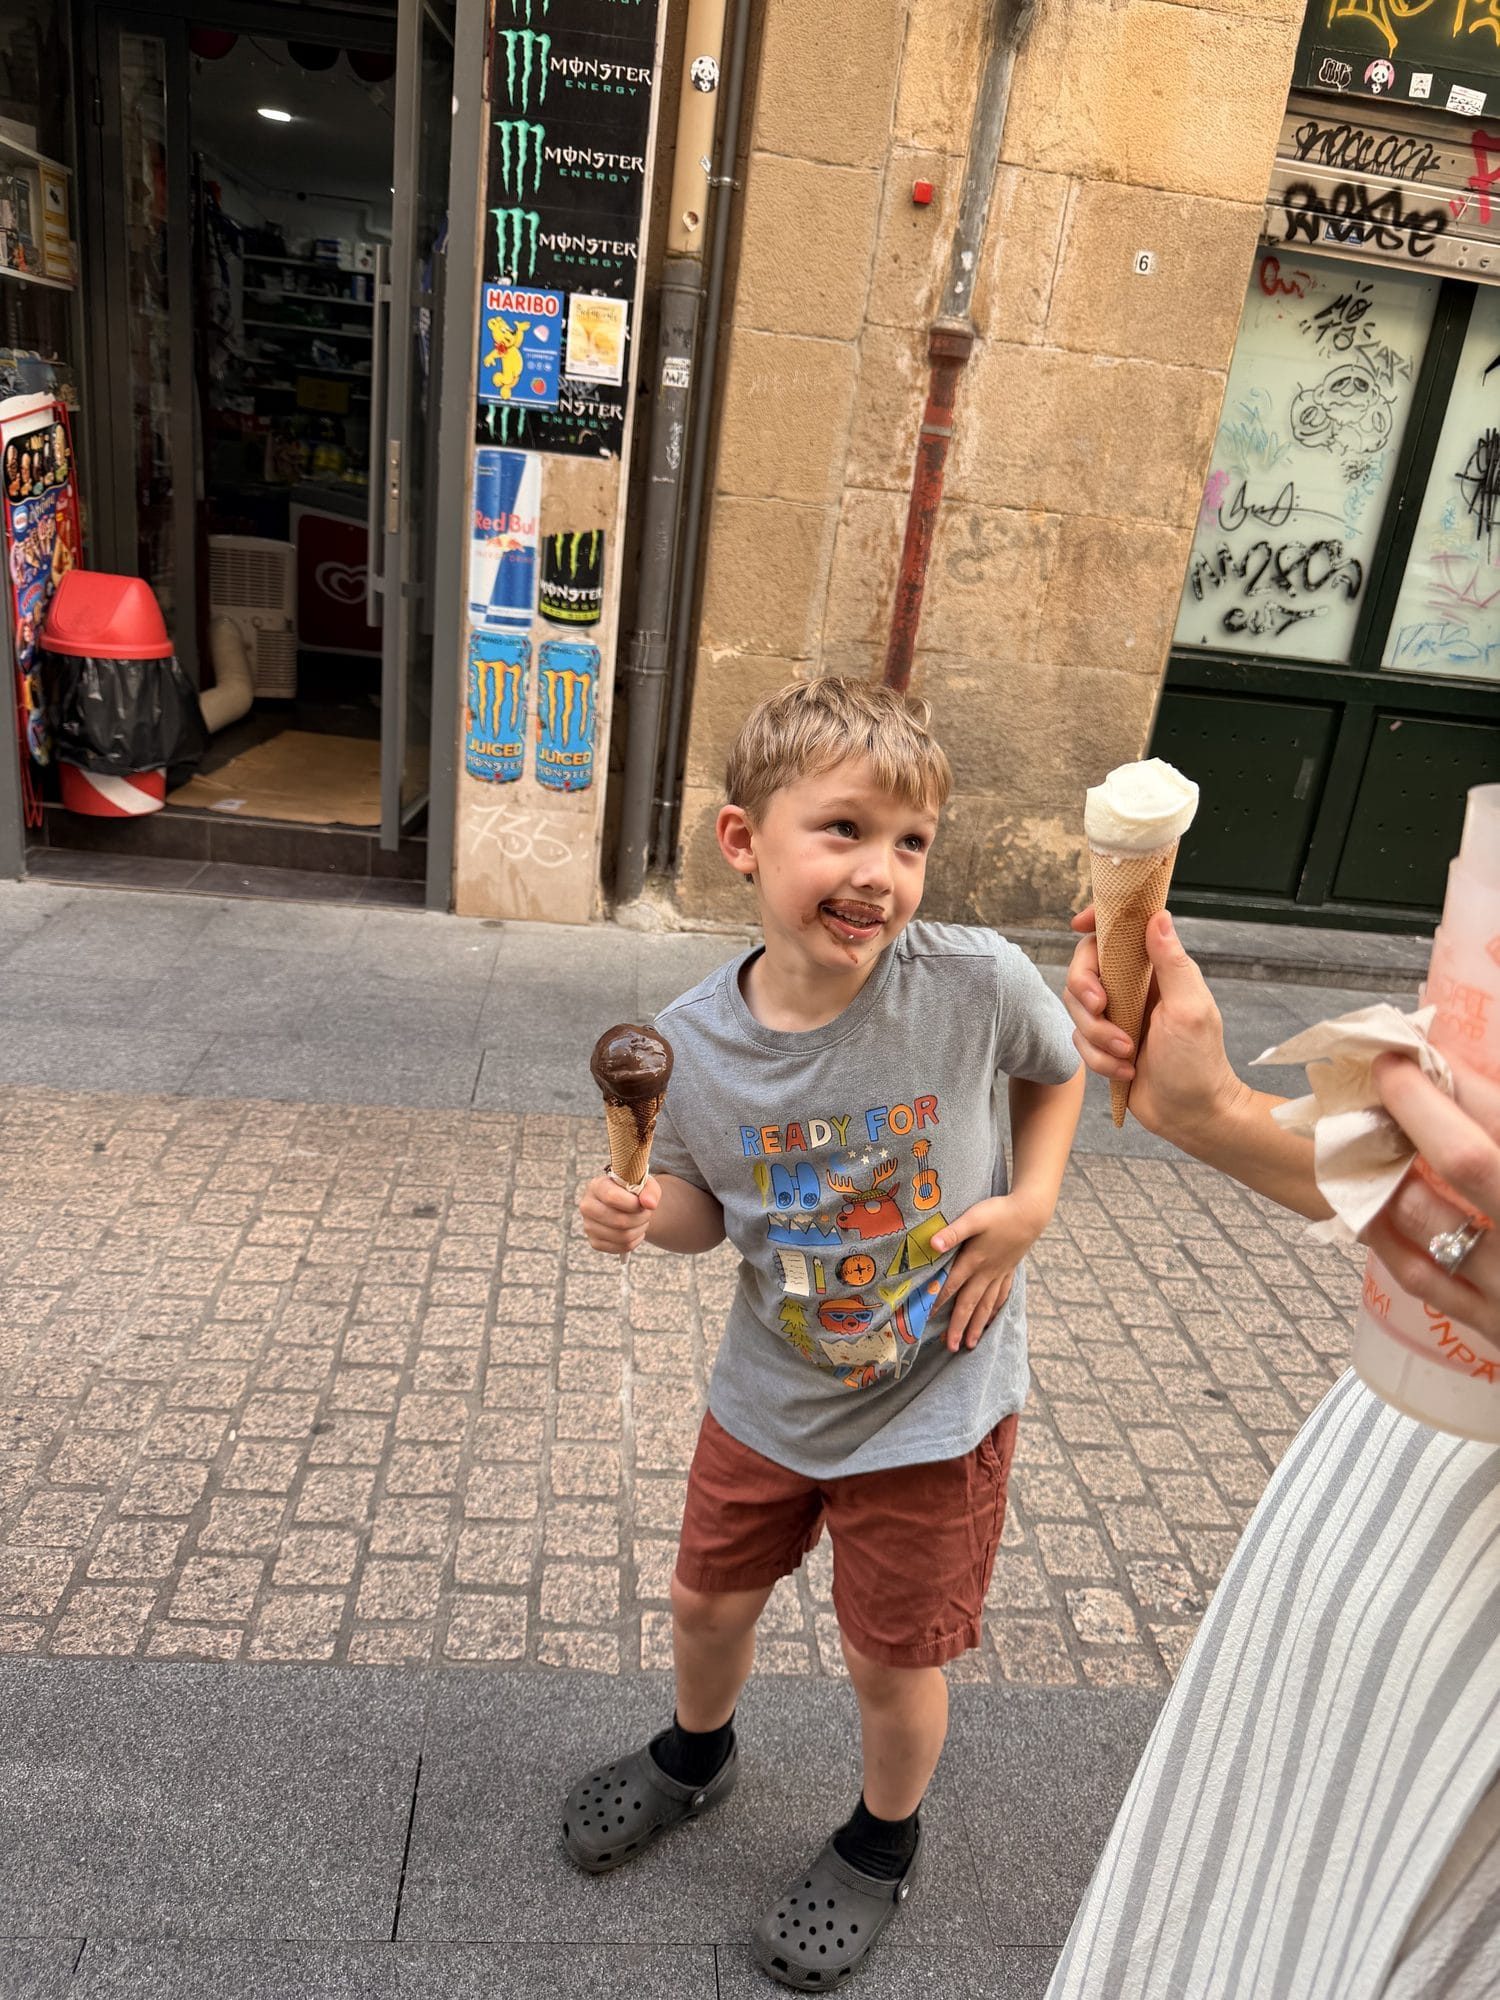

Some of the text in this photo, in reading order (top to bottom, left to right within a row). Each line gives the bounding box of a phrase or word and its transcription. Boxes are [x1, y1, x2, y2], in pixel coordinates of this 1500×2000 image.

[550, 56, 652, 86] MONSTER
[565, 79, 637, 96] ENERGY
[544, 145, 645, 173] MONSTER
[559, 168, 630, 183] ENERGY
[539, 232, 638, 259] MONSTER
[553, 253, 624, 269] ENERGY
[1139, 255, 1149, 271] 6
[487, 288, 560, 316] HARIBO
[560, 398, 623, 420] NSTER
[475, 510, 506, 532] Red
[469, 804, 573, 868] 735
[739, 1094, 939, 1156] READY FOR
